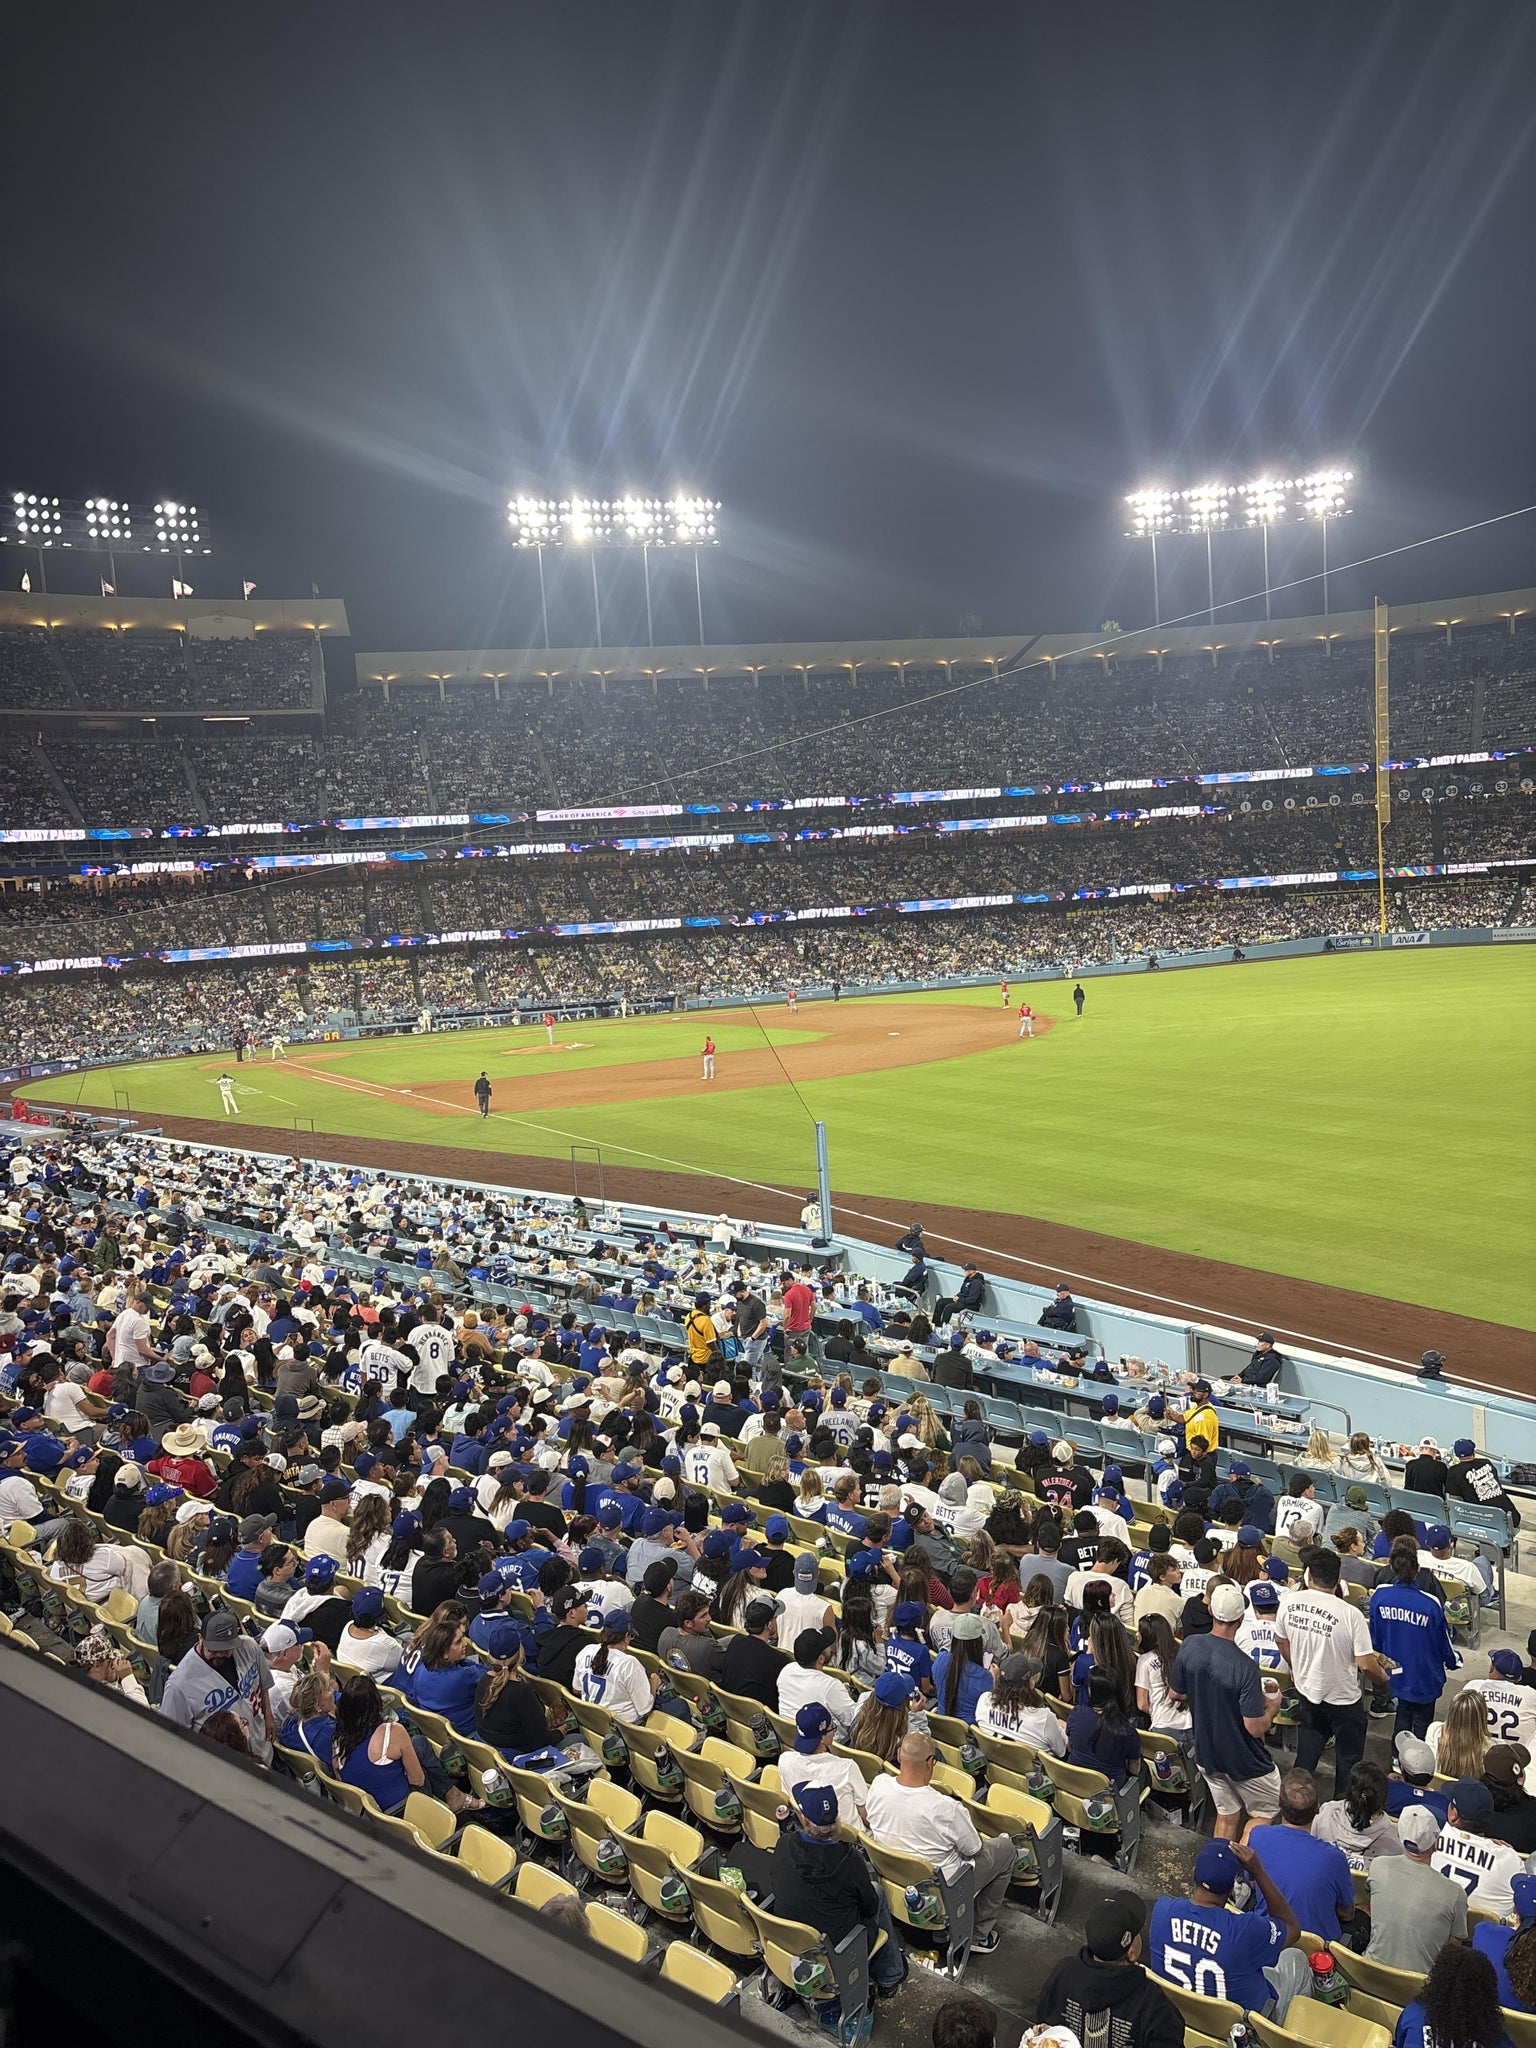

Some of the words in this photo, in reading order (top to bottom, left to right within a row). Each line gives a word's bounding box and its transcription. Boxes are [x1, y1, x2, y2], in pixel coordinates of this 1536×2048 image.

[1430, 756, 1456, 766] ANDY
[1457, 753, 1489, 763] PAGES
[1262, 770, 1283, 780] ANDY
[1285, 768, 1313, 778] PAGES
[1104, 781, 1126, 790] ANDY
[1126, 779, 1152, 788] PAGES
[953, 790, 973, 799] ANDY
[975, 788, 1001, 797] PAGES
[795, 798, 817, 808] ANDY
[818, 797, 845, 806] PAGES
[1150, 808, 1172, 817] ANDY
[1173, 806, 1200, 815] PAGES
[413, 816, 436, 826] ANDY
[439, 815, 469, 824] PAGES
[1000, 818, 1021, 827] ANDY
[1022, 816, 1047, 825] PAGES
[222, 824, 249, 835] ANDY
[250, 823, 282, 833] PAGES
[844, 827, 865, 836] ANDY
[866, 825, 894, 835] PAGES
[21, 830, 48, 841] ANDY
[51, 830, 85, 840] PAGES
[683, 836, 706, 846] ANDY
[707, 834, 734, 844] PAGES
[510, 844, 535, 855] ANDY
[536, 843, 565, 853] PAGES
[327, 853, 354, 864] ANDY
[354, 852, 386, 862] PAGES
[132, 862, 159, 873] ANDY
[160, 861, 194, 872] PAGES
[1283, 874, 1306, 884] ANDY
[1307, 872, 1337, 881] PAGES
[1120, 886, 1143, 895] ANDY
[1143, 884, 1170, 893] PAGES
[962, 897, 984, 907] ANDY
[986, 895, 1013, 905] PAGES
[798, 909, 821, 919] ANDY
[822, 907, 850, 917] PAGES
[626, 920, 650, 931] ANDY
[651, 918, 681, 928] PAGES
[441, 932, 468, 942] ANDY
[469, 930, 501, 940] PAGES
[1395, 935, 1415, 943] ANA
[243, 944, 272, 956] ANDY
[273, 943, 306, 953] PAGES
[34, 959, 64, 971] ANDY
[65, 957, 102, 969] PAGES
[430, 1342, 440, 1359] 8
[370, 1353, 390, 1363] BETTS
[369, 1364, 389, 1383] 50
[661, 1402, 673, 1418] 17
[821, 1417, 854, 1428] FREELAND
[122, 1449, 135, 1459] ETTS
[694, 1464, 708, 1485] 13
[865, 1483, 883, 1492] OHTA
[1046, 1489, 1073, 1508] 34
[935, 1505, 957, 1521] BETTS
[826, 1512, 853, 1533] OHTANI
[1078, 1546, 1098, 1559] BETT
[1432, 1569, 1454, 1580] ETTS
[1133, 1571, 1153, 1591] 17
[1287, 1603, 1339, 1626] GENTLEMEN'S
[1379, 1606, 1429, 1628] BROOKLYN
[1288, 1614, 1309, 1625] FIGHT
[1312, 1620, 1333, 1632] CLUB
[1250, 1646, 1280, 1668] 17
[582, 1672, 607, 1702] 17
[989, 1710, 1023, 1733] MUNCY
[1488, 1708, 1520, 1741] 22
[823, 1800, 830, 1811] B
[1437, 1836, 1496, 1871] OHTANI
[1170, 1917, 1222, 1955] BETTS
[1164, 1944, 1226, 2000] 50
